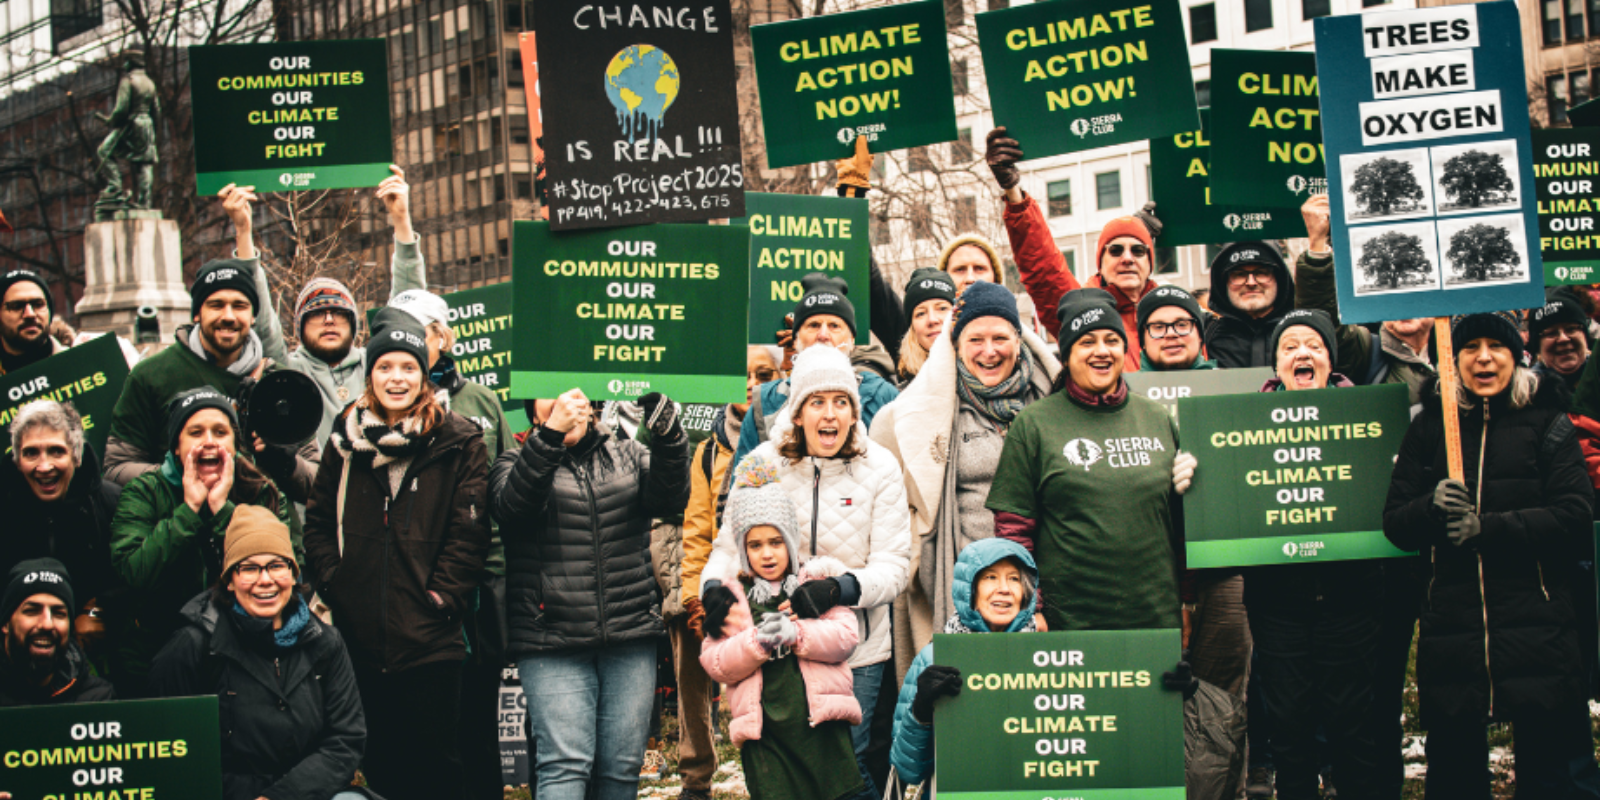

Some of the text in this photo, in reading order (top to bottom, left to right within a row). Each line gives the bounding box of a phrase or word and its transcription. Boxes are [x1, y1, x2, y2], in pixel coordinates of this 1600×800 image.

[574, 4, 718, 32] CHANGE
[1005, 5, 1154, 51] CLIMATE
[1364, 19, 1471, 49] TREES
[779, 23, 922, 63] CLIMATE
[270, 56, 310, 70] OUR
[1024, 40, 1149, 82] ACTION
[217, 71, 364, 91] COMMUNITIES
[795, 55, 914, 93] ACTION
[1375, 64, 1469, 92] MAKE
[272, 91, 312, 105] OUR
[1046, 76, 1136, 112] NOW!
[815, 89, 901, 121] NOW!
[247, 107, 340, 124] CLIMATE
[1091, 113, 1122, 125] SIERRA
[1248, 106, 1319, 130] ACT
[1363, 104, 1497, 138] OXYGEN
[274, 126, 315, 140] OUR
[856, 123, 886, 134] SIERRA
[1092, 123, 1114, 135] CLUB
[264, 142, 326, 159] FIGHT
[567, 141, 592, 162] IS
[1546, 143, 1590, 158] OUR
[1548, 180, 1592, 195] OUR
[701, 194, 731, 210] 675
[749, 214, 851, 238] CLIMATE
[1242, 213, 1271, 222] SIERRA
[1242, 220, 1263, 229] CLUB
[1550, 217, 1593, 231] OUR
[608, 241, 656, 256] OUR
[757, 248, 843, 270] ACTION
[544, 260, 719, 279] COMMUNITIES
[607, 282, 655, 298] OUR
[447, 303, 486, 321] OUR
[577, 303, 684, 320] CLIMATE
[606, 324, 654, 340] OUR
[451, 338, 492, 356] OUR
[594, 345, 666, 361] FIGHT
[464, 372, 499, 386] UR
[8, 376, 50, 400] OUR
[1147, 386, 1191, 399] OUR
[1271, 406, 1318, 423] OUR
[680, 417, 713, 432] CLUB
[1210, 421, 1382, 448] COMMUNITIES
[1105, 437, 1164, 454] SIERRA
[1107, 451, 1151, 467] CLUB
[1274, 447, 1321, 463] OUR
[1246, 465, 1352, 486] CLIMATE
[1277, 487, 1324, 504] OUR
[1266, 507, 1337, 525] FIGHT
[1033, 651, 1084, 667] OUR
[967, 670, 1150, 690] COMMUNITIES
[1034, 694, 1084, 710] OUR
[71, 722, 121, 740] OUR
[1004, 715, 1117, 733] CLIMATE
[4, 740, 188, 768] COMMUNITIES
[1035, 738, 1086, 755] OUR
[73, 767, 123, 786] OUR
[1024, 760, 1099, 777] FIGHT
